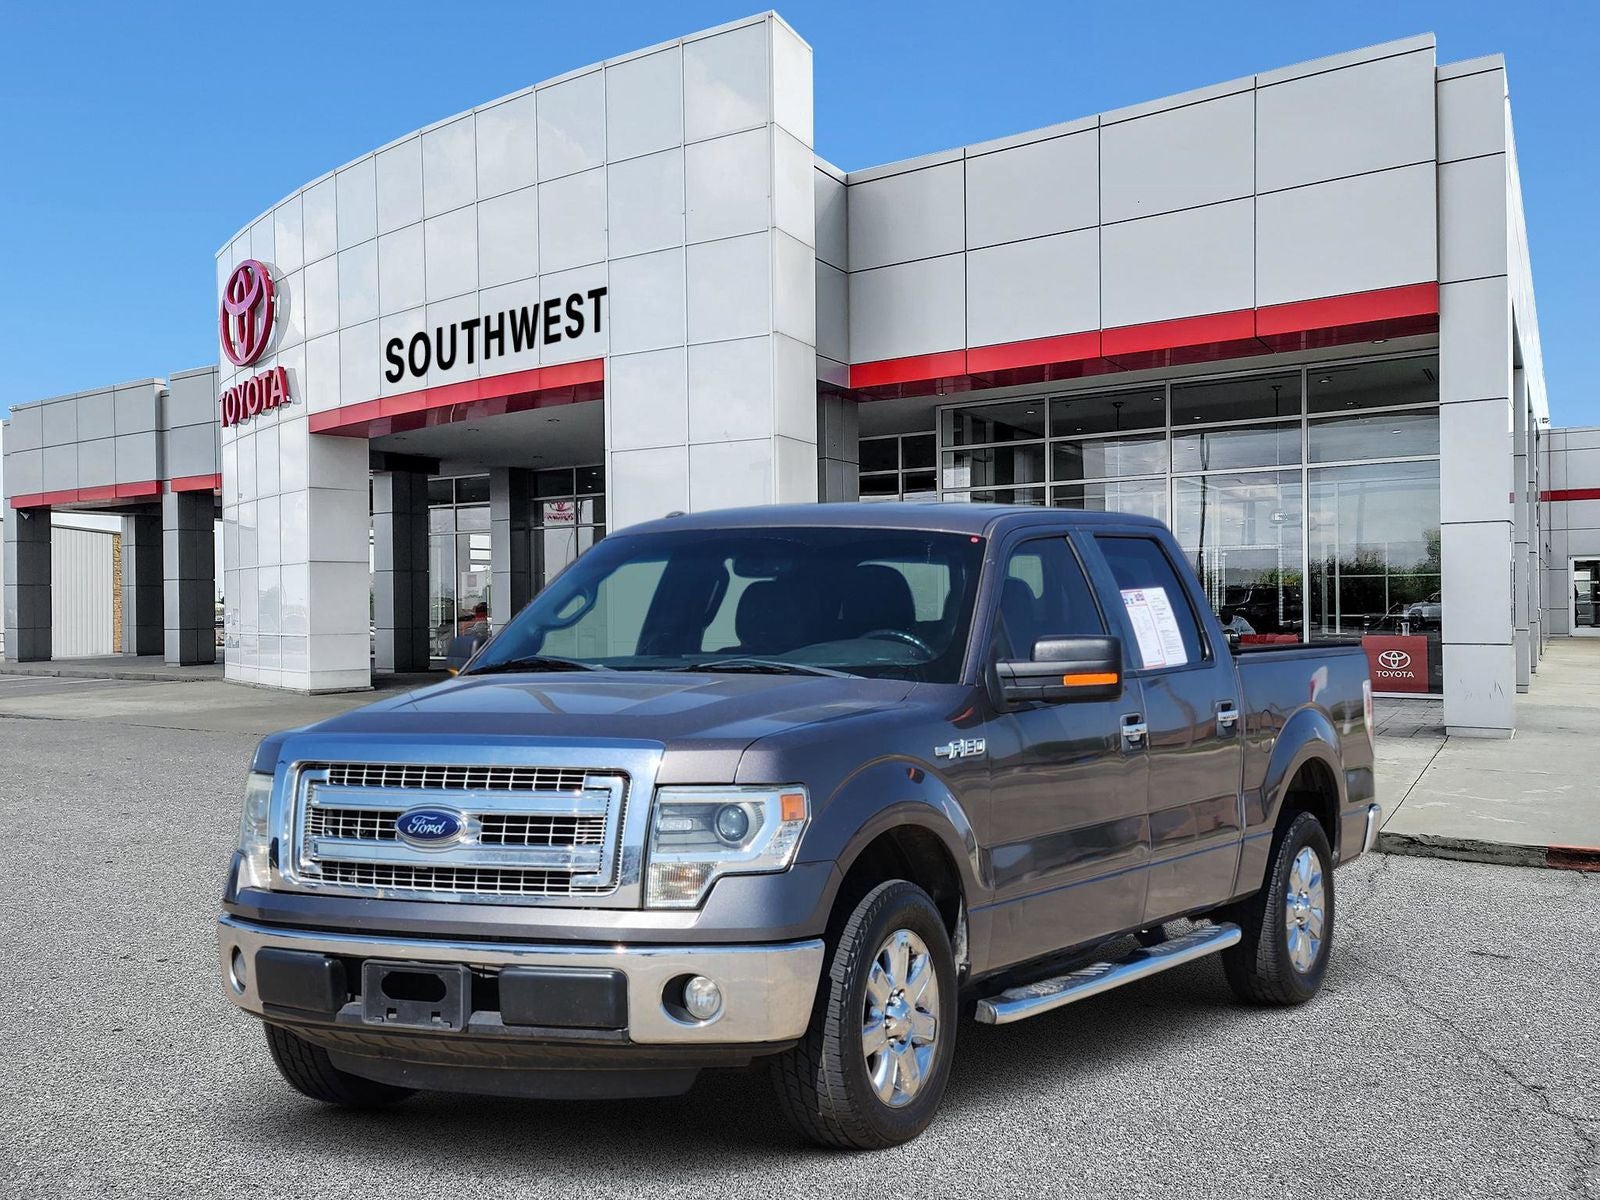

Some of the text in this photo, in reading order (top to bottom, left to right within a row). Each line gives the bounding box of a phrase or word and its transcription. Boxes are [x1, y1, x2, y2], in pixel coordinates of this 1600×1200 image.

[385, 287, 607, 383] SOUTHWEST
[218, 366, 291, 427] TOYOTA
[1376, 670, 1414, 678] TOYOTA
[407, 815, 447, 834] Ford
